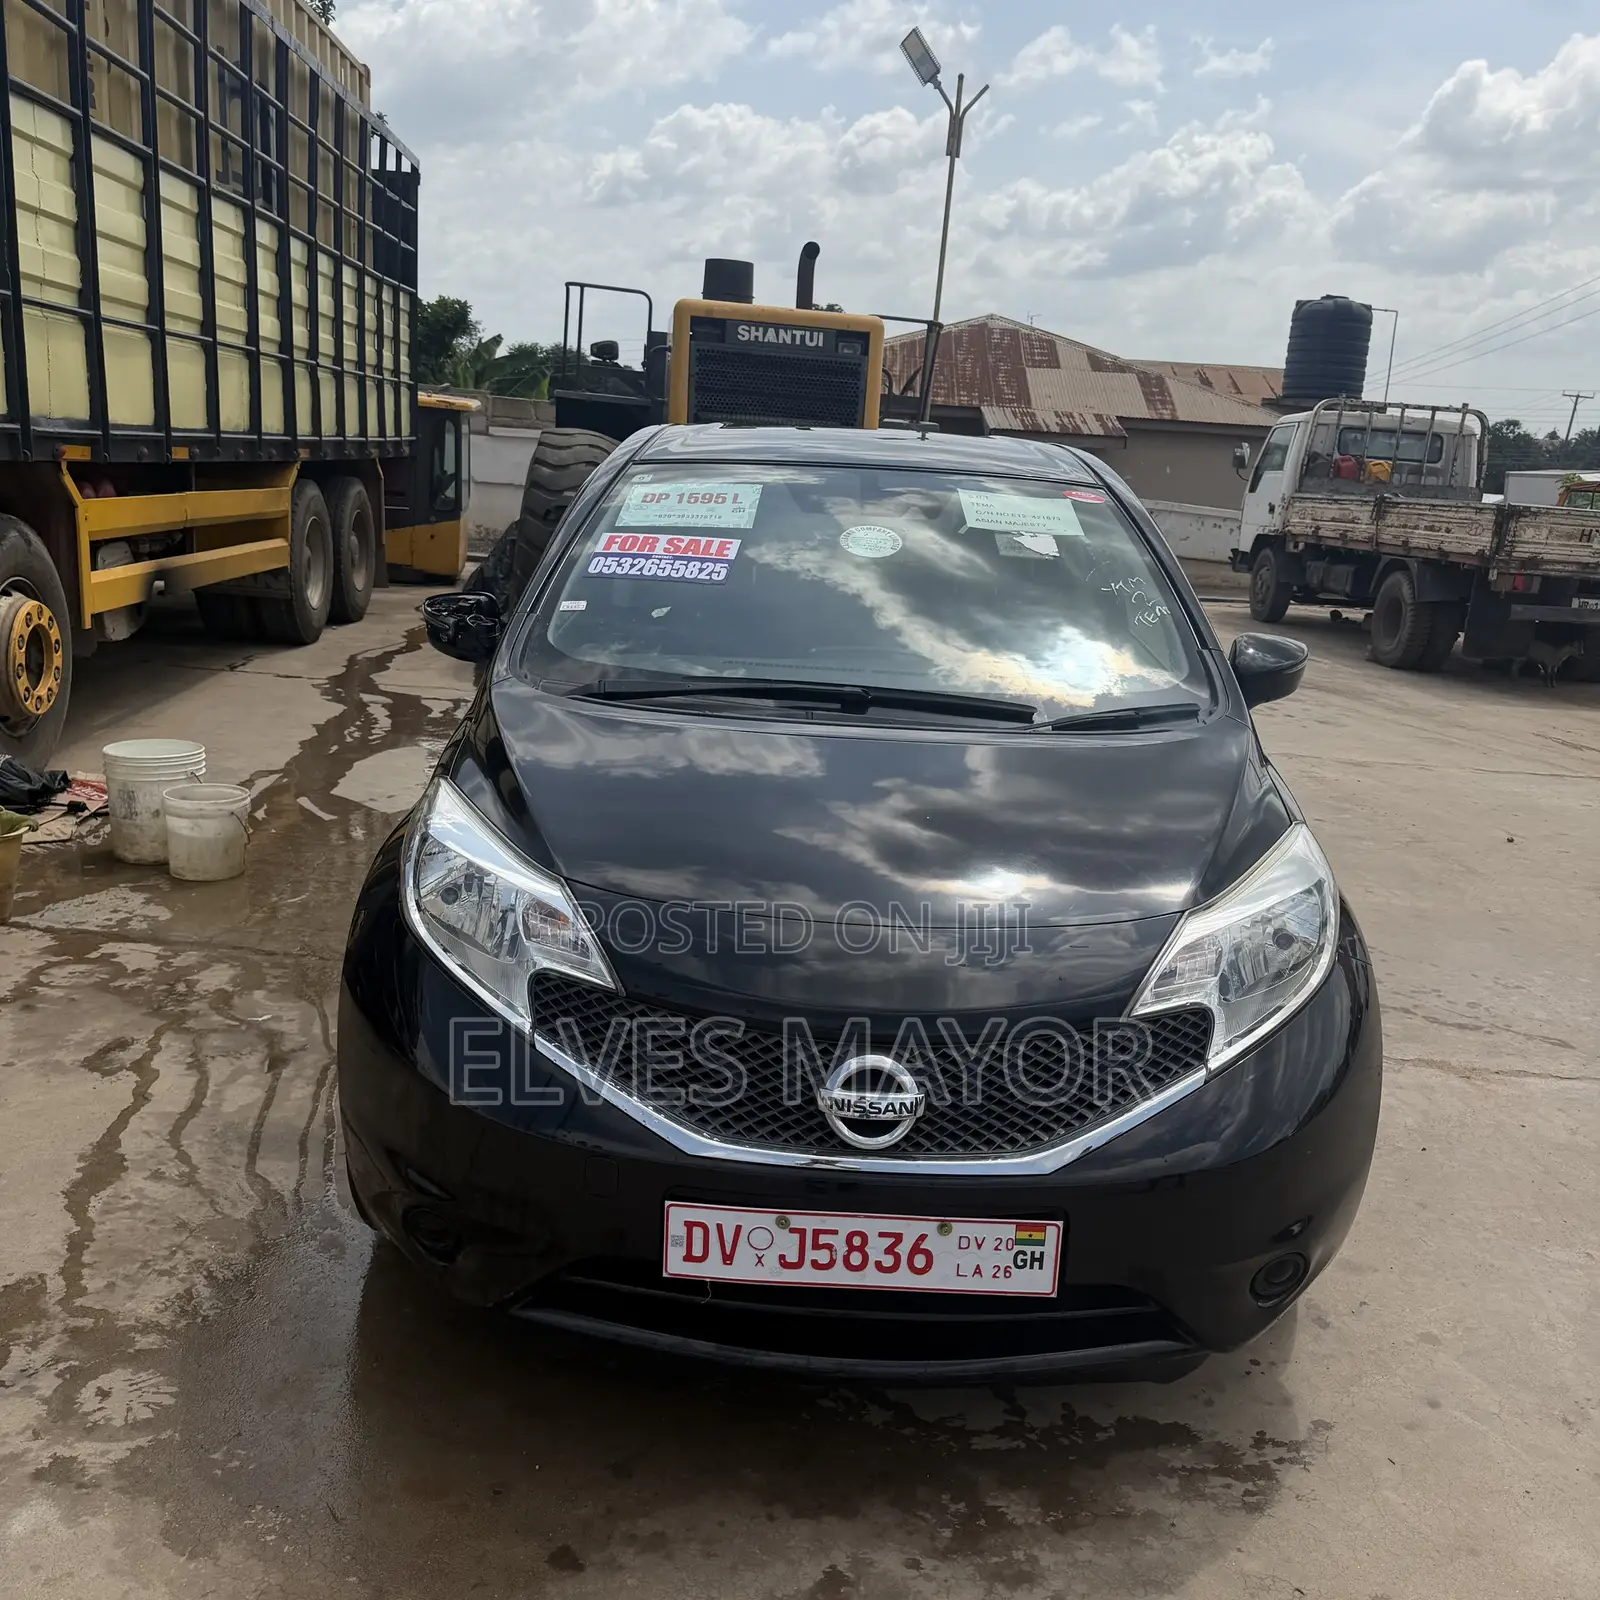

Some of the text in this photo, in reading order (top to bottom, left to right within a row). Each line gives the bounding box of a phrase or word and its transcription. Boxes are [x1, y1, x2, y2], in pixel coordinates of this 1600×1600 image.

[737, 325, 824, 347] SHANTUI
[640, 492, 743, 504] DP 1595 L
[602, 534, 734, 558] FOR SALE
[588, 556, 730, 581] 0532655825
[828, 1096, 915, 1116] NISSAN
[682, 1220, 934, 1276] DV J5836
[958, 1235, 1015, 1252] DV 20
[1012, 1249, 1045, 1270] GH
[956, 1263, 1013, 1279] LA 26
